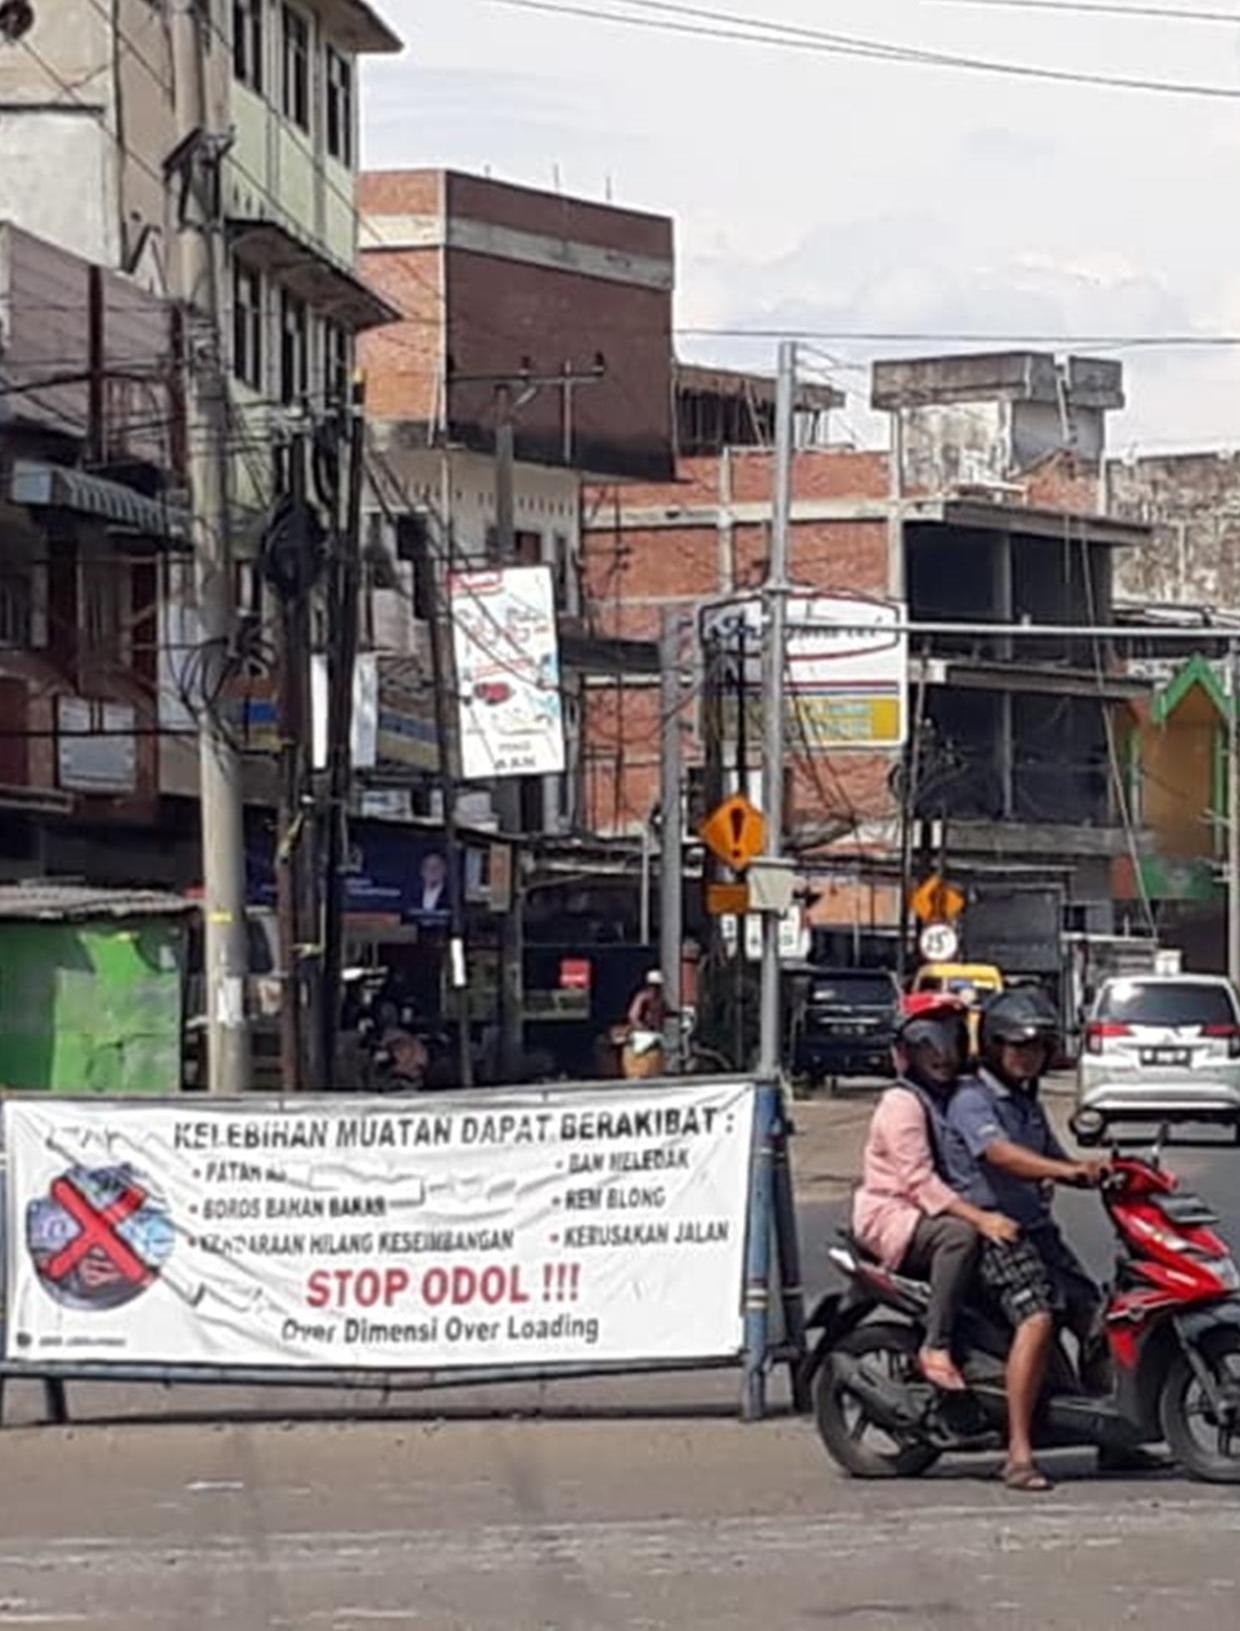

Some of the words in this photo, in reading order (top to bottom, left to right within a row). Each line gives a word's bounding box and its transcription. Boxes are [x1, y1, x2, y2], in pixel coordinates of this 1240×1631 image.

[174, 1120, 328, 1149] KELEBIHAN
[336, 1117, 452, 1148] MUATAN
[461, 1114, 552, 1145] DAPAT
[560, 1107, 718, 1141] BERAKIBAT
[203, 1196, 261, 1219] BOROS
[265, 1197, 324, 1219] BAHAN
[565, 1187, 603, 1211] REM
[606, 1185, 666, 1209] BLONG
[309, 1231, 374, 1254] HILANG
[377, 1228, 514, 1254] KESEIMBANGAN
[563, 1223, 669, 1248] KERUSAKAN
[674, 1220, 729, 1244] JALAN
[306, 1266, 410, 1308] STOP
[421, 1263, 530, 1306] ODOL
[542, 1261, 581, 1302] !!!
[281, 1317, 336, 1344] Over
[343, 1316, 438, 1344] Dimensi
[445, 1315, 500, 1342] Over
[507, 1312, 600, 1345] Loading
